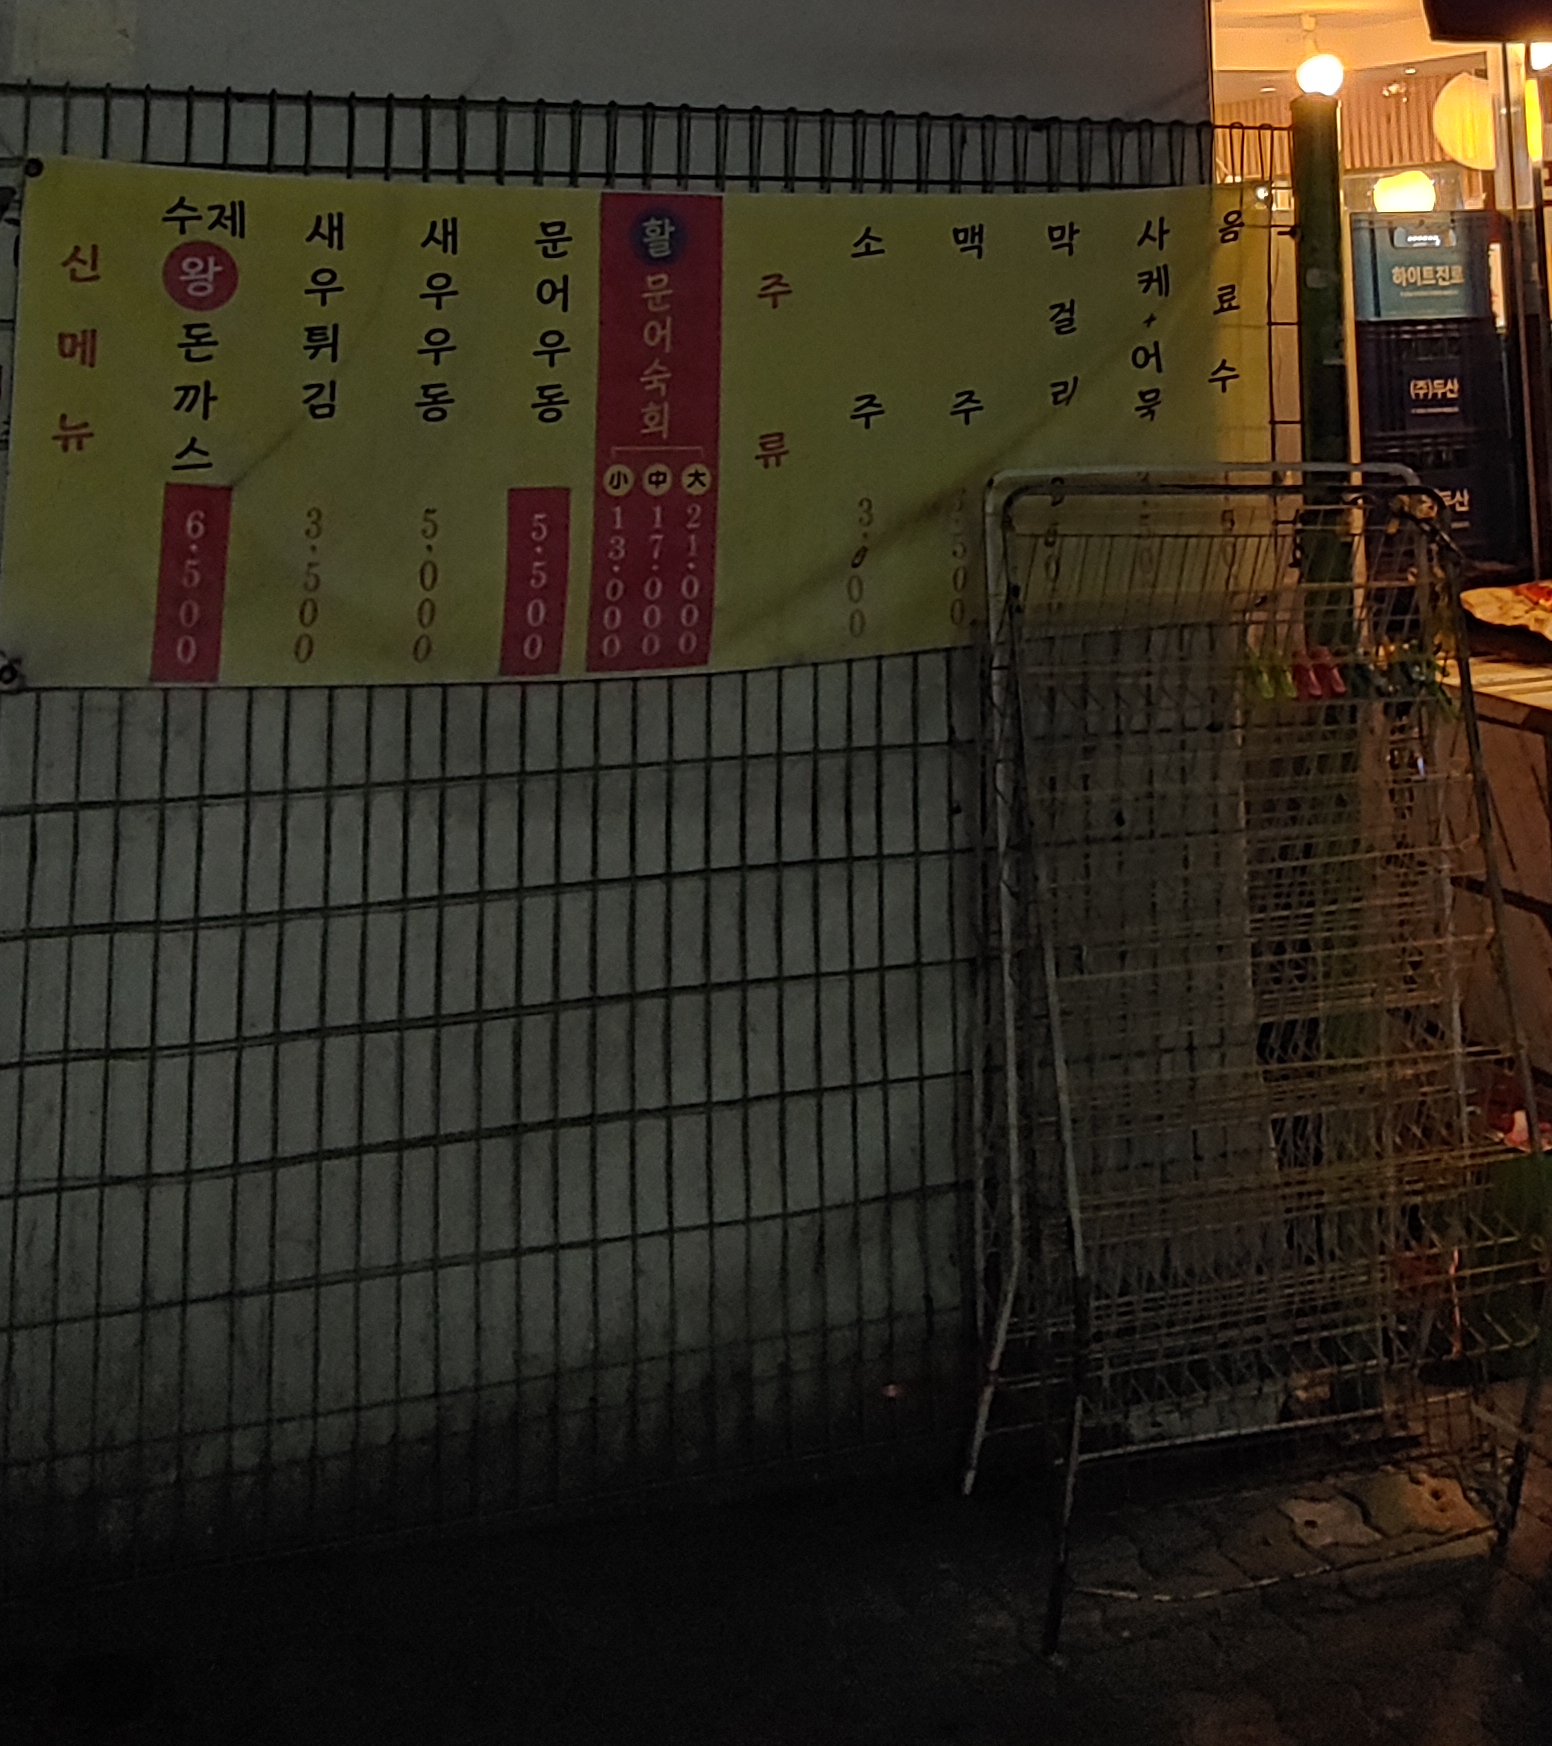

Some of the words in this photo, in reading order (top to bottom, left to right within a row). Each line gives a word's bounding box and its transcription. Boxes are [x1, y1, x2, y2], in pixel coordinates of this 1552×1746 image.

[161, 195, 247, 240] 수제
[302, 212, 345, 421] 새우튀김
[414, 216, 460, 423] 새우우동
[1391, 265, 1465, 287] 하이트진로
[531, 220, 572, 425] 문어우동
